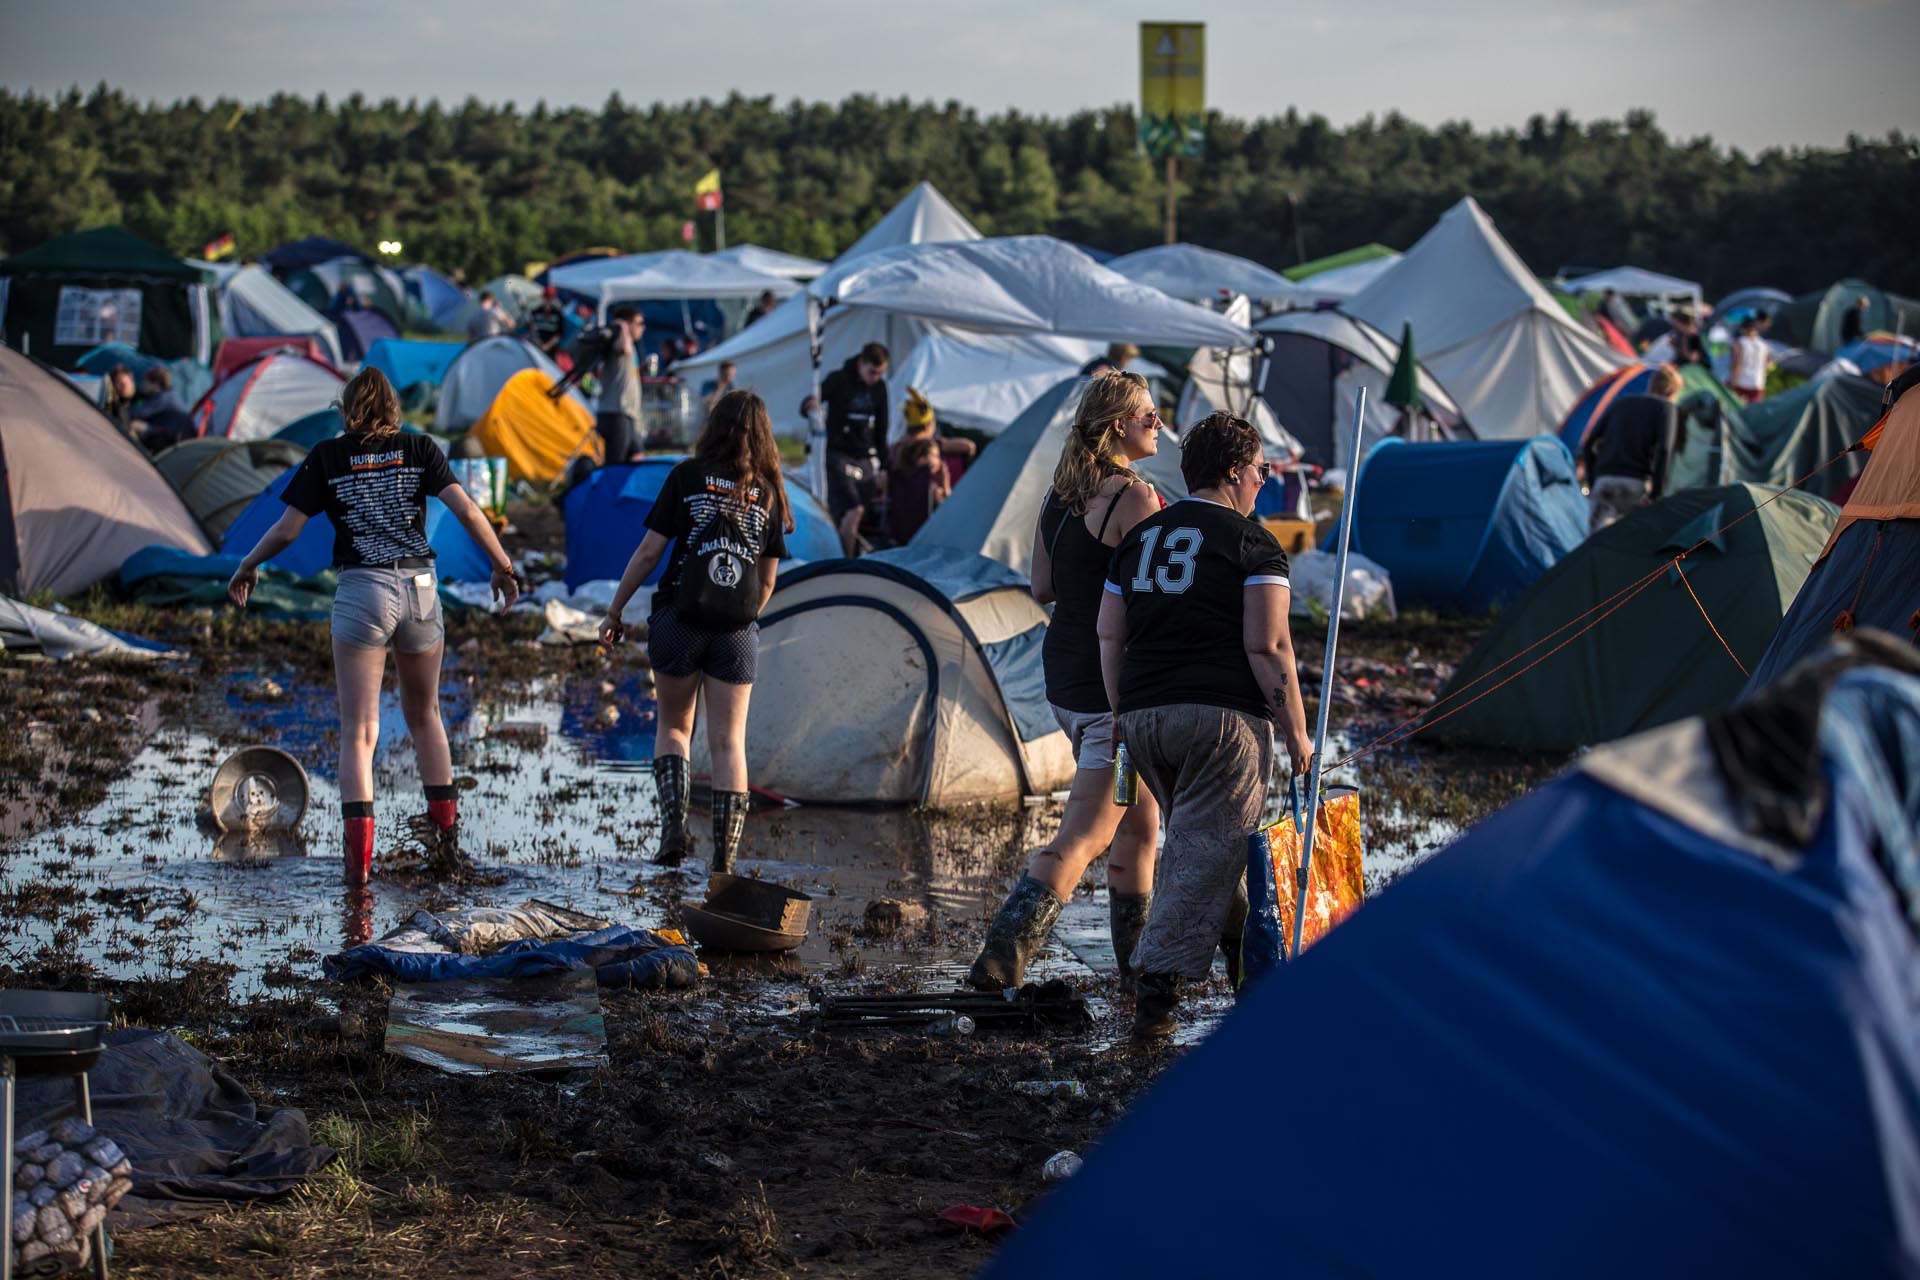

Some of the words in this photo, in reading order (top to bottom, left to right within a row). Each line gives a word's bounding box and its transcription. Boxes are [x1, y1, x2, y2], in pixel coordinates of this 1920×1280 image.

[350, 450, 404, 466] HURRICANE
[705, 476, 760, 497] HRRINE
[1131, 525, 1205, 594] 13
